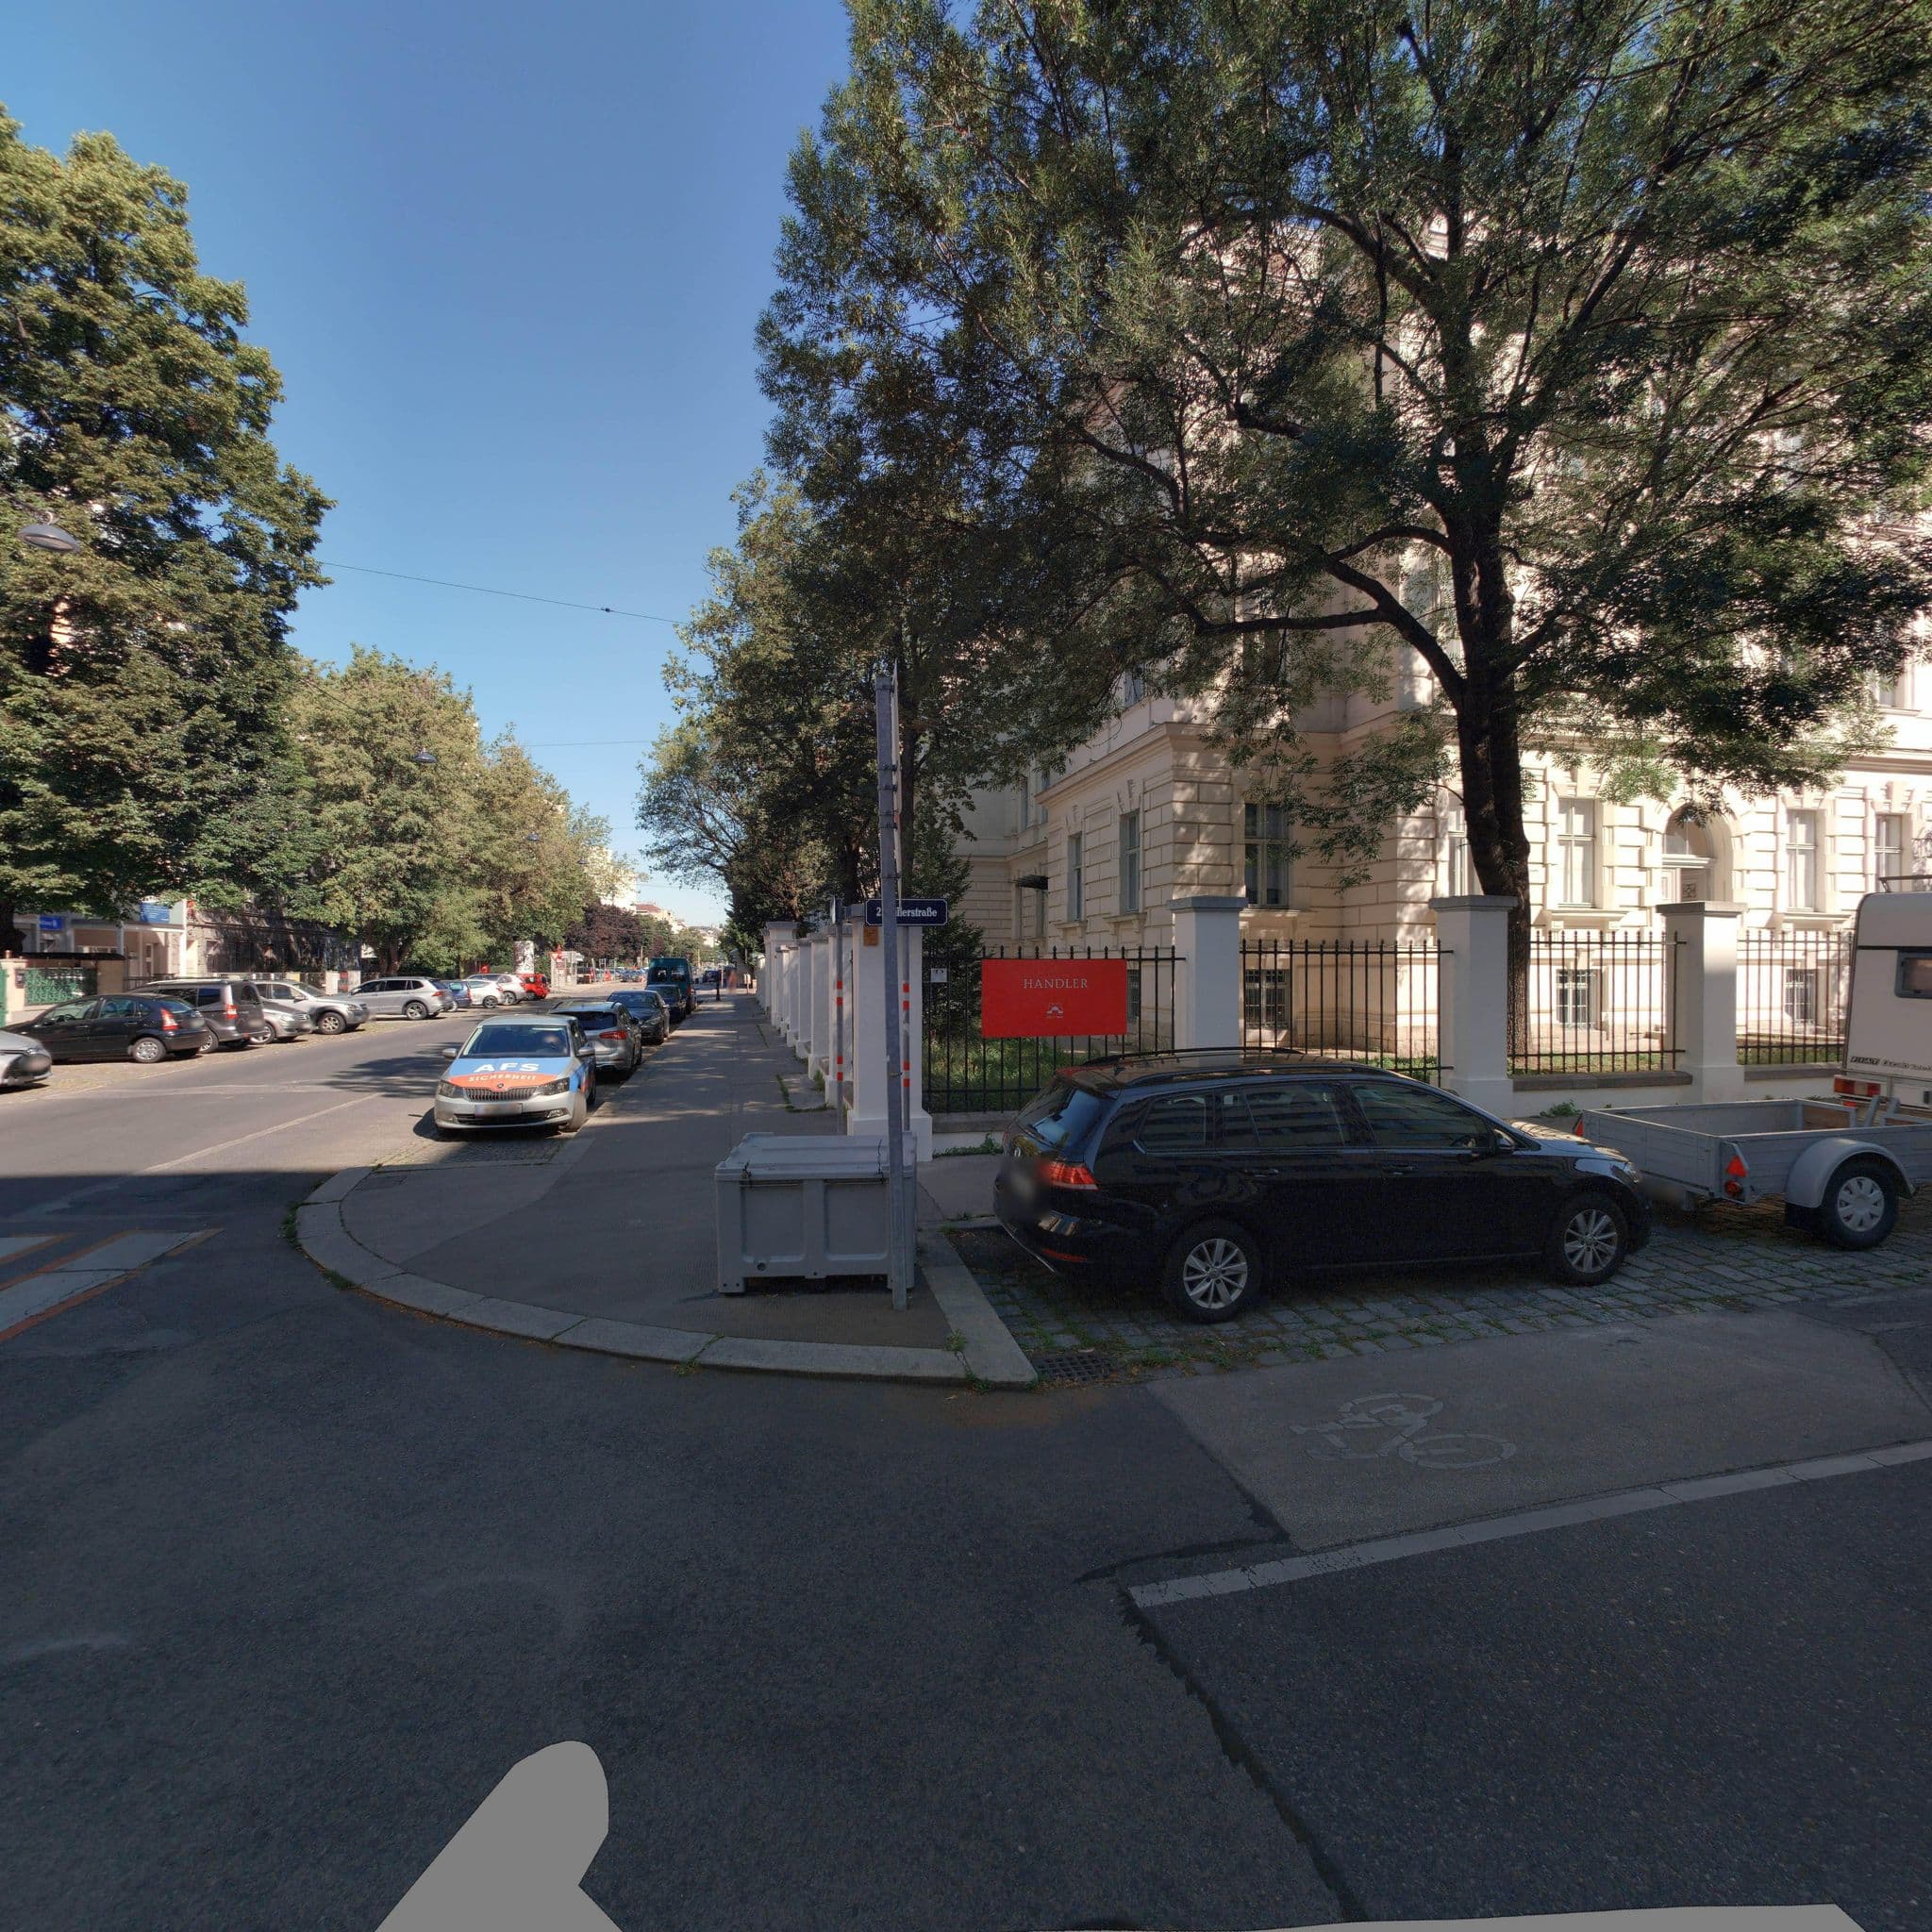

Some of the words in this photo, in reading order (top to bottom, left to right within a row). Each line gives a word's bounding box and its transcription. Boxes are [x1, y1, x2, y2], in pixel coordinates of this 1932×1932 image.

[893, 907, 938, 918] llerstraße
[1024, 978, 1088, 989] HANDLER
[1850, 1056, 1880, 1065] FIAT
[474, 1062, 540, 1073] AFS
[468, 1074, 536, 1082] SICHERHEIT
